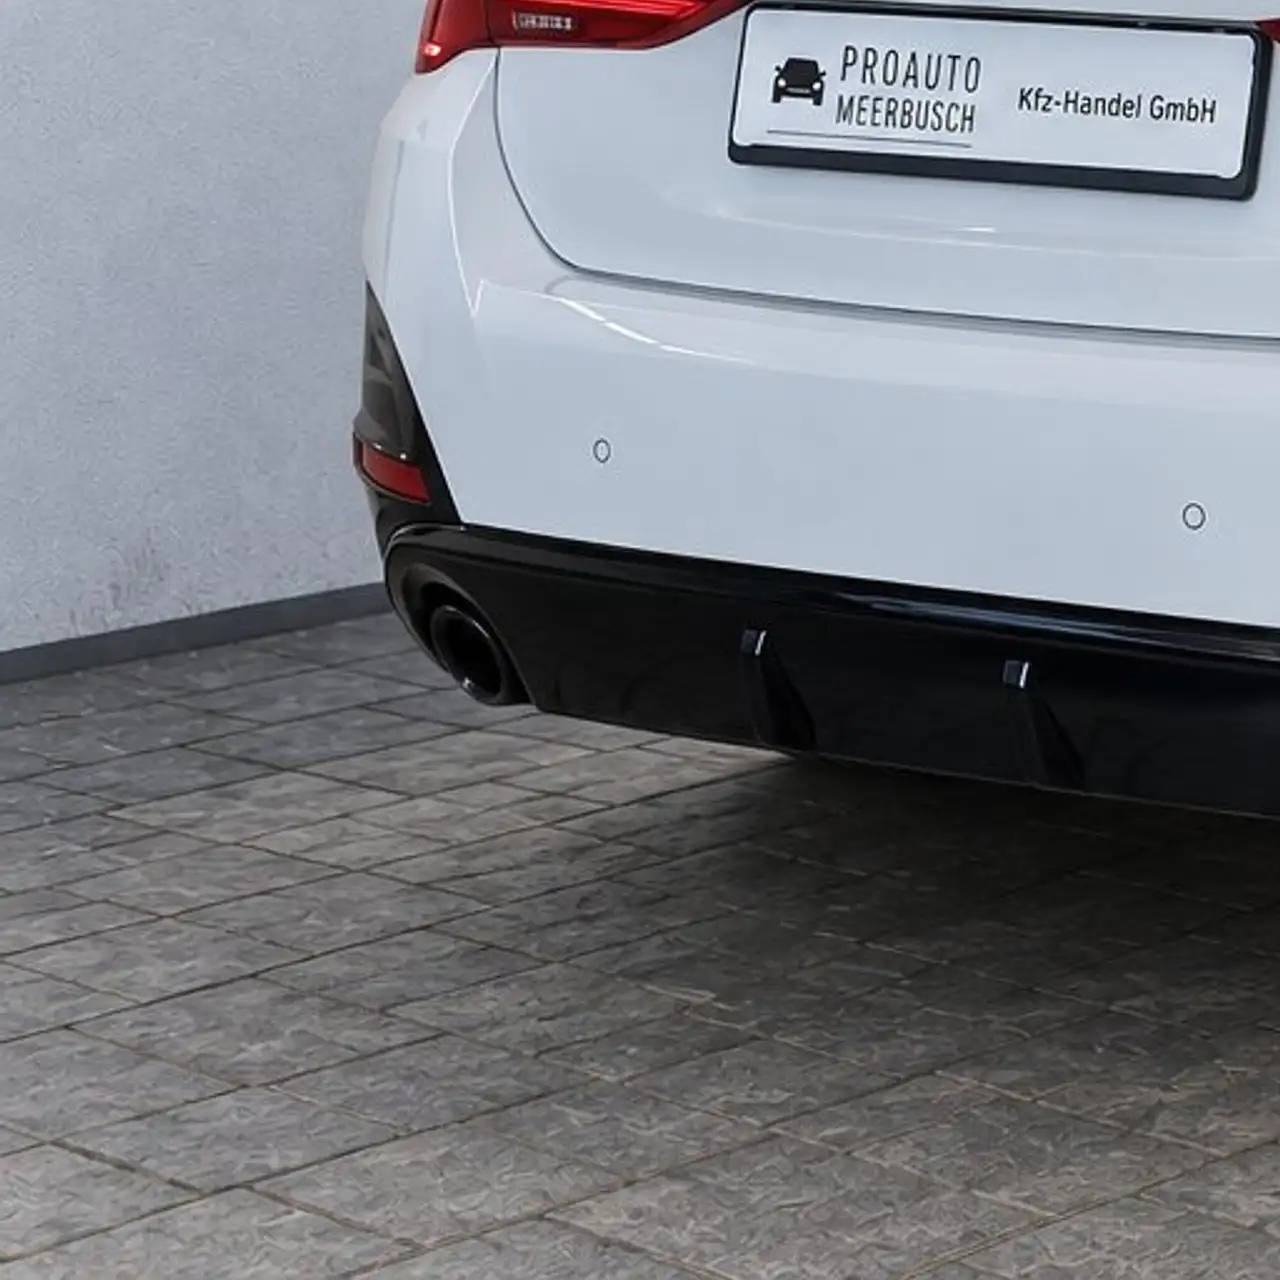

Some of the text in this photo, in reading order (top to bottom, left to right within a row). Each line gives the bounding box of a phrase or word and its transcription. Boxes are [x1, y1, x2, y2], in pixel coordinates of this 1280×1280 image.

[840, 45, 981, 94] PROAUTO
[835, 94, 975, 134] MEERBUSCH
[1018, 87, 1217, 123] Kfz-Handel GmbH
